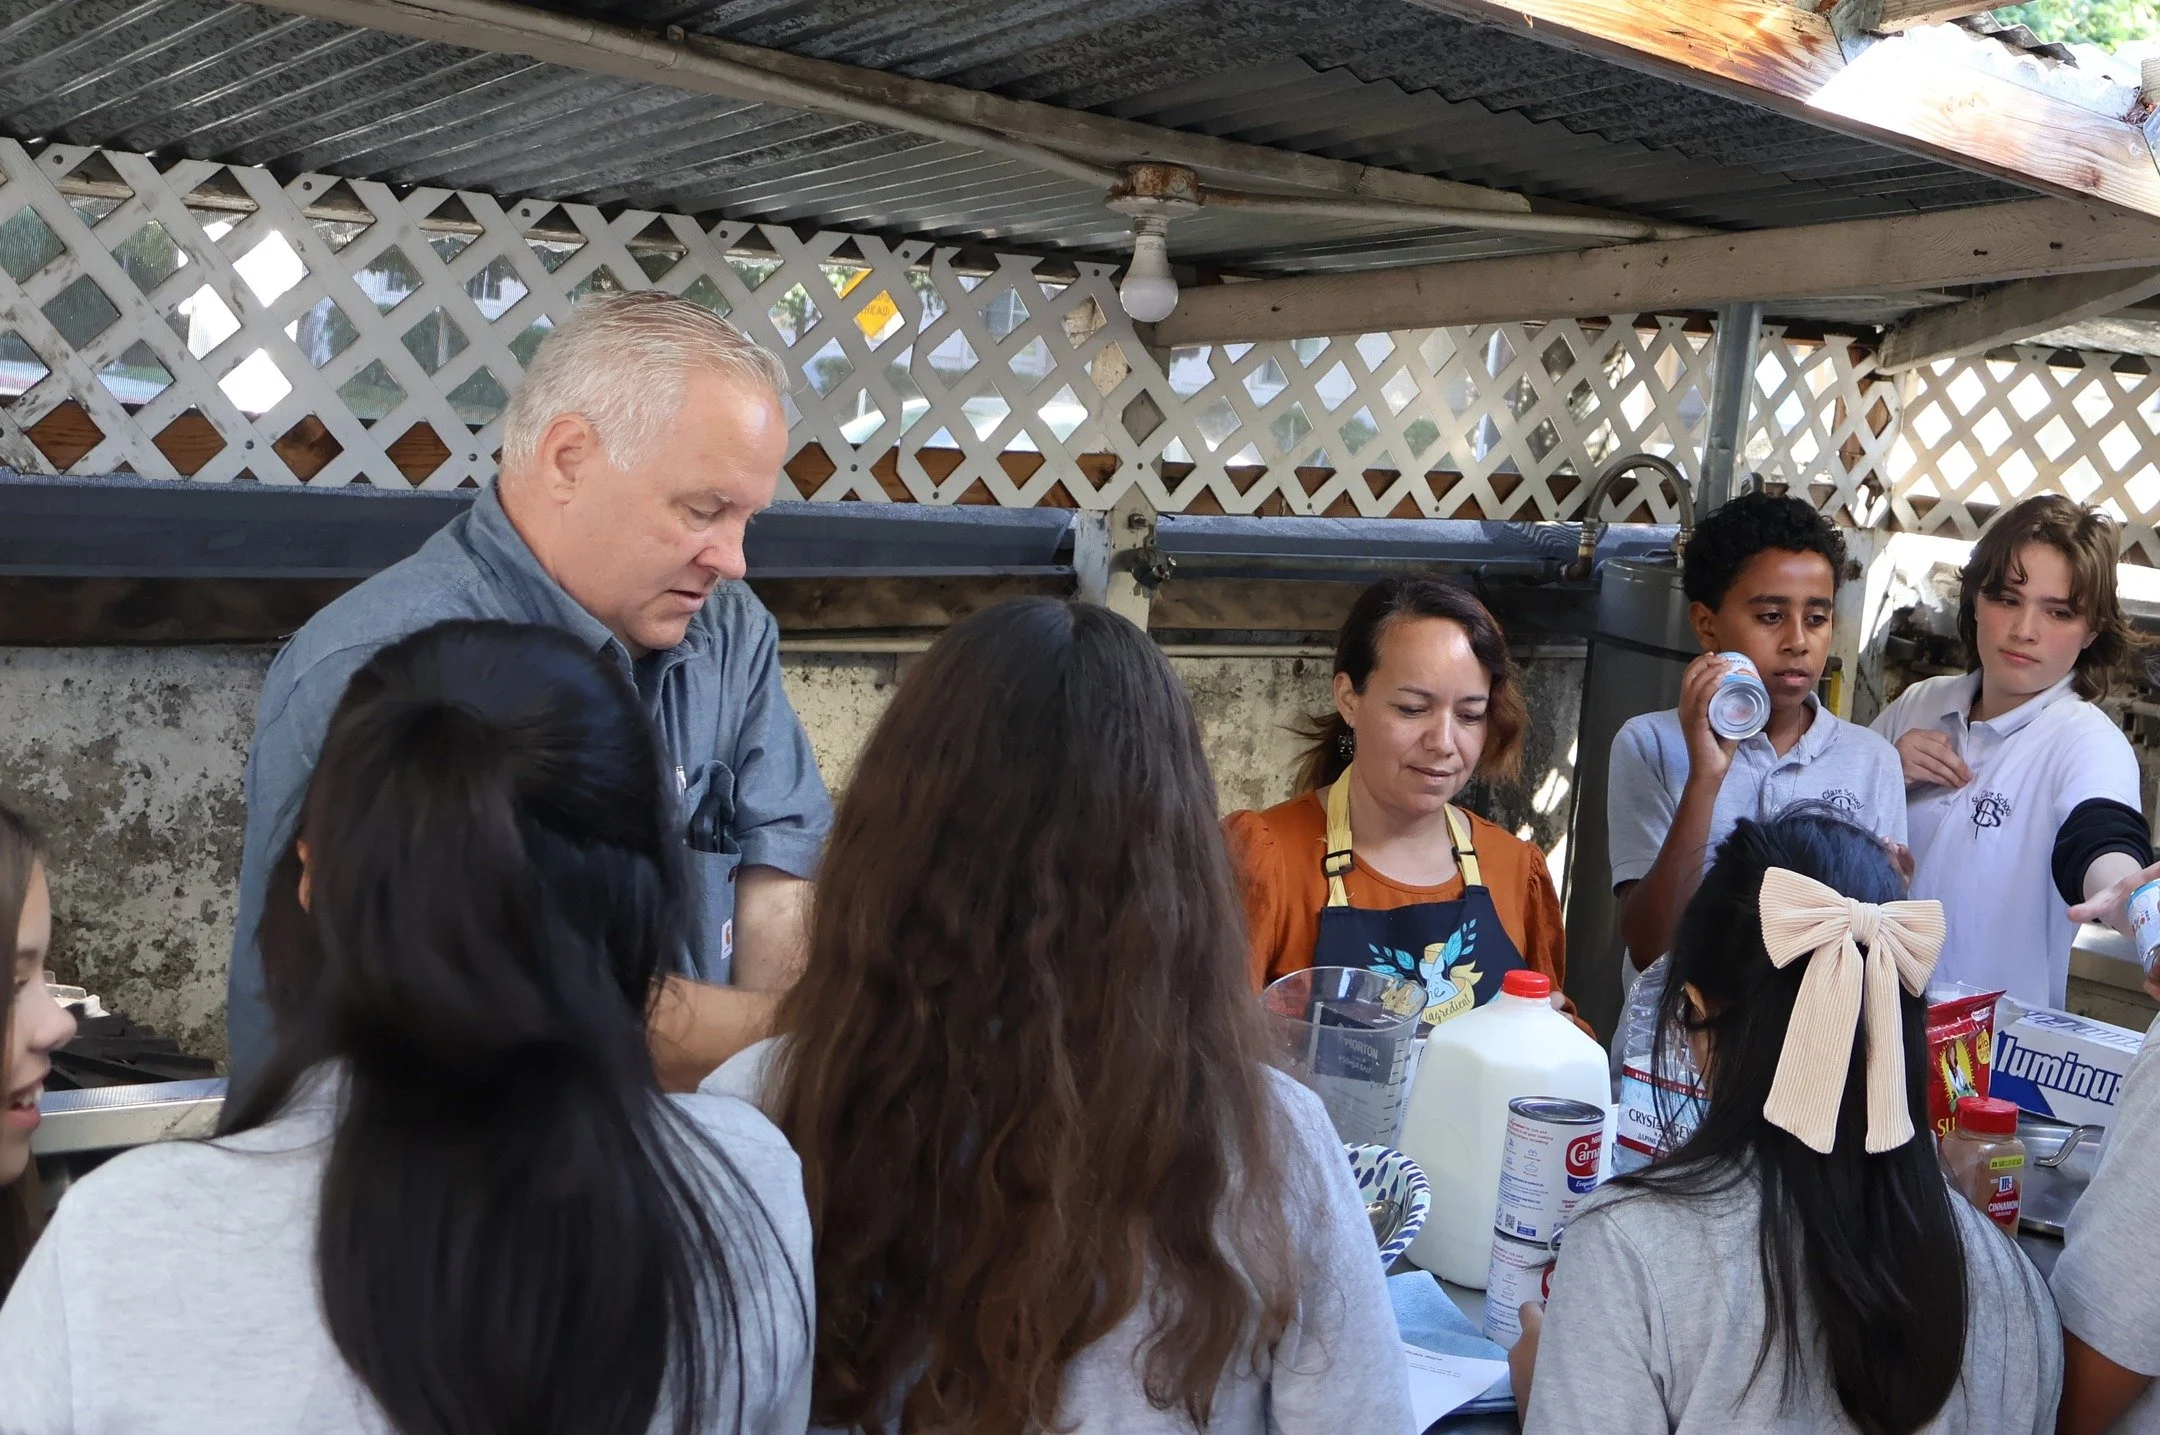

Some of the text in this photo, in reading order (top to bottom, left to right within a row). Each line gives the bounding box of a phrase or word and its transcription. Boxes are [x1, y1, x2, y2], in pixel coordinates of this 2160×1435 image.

[1821, 788, 1865, 810] Clare School
[1994, 792, 2012, 817] School
[1425, 993, 1472, 1024] ingredient
[1343, 1037, 1379, 1060] MORTON
[1628, 1108, 1661, 1131] CRYSTA
[1673, 1123, 1693, 1140] GEY
[1938, 1116, 1956, 1137] SU
[1637, 1133, 1657, 1145] ALPINE
[1988, 1200, 2019, 1213] CINNAMON
